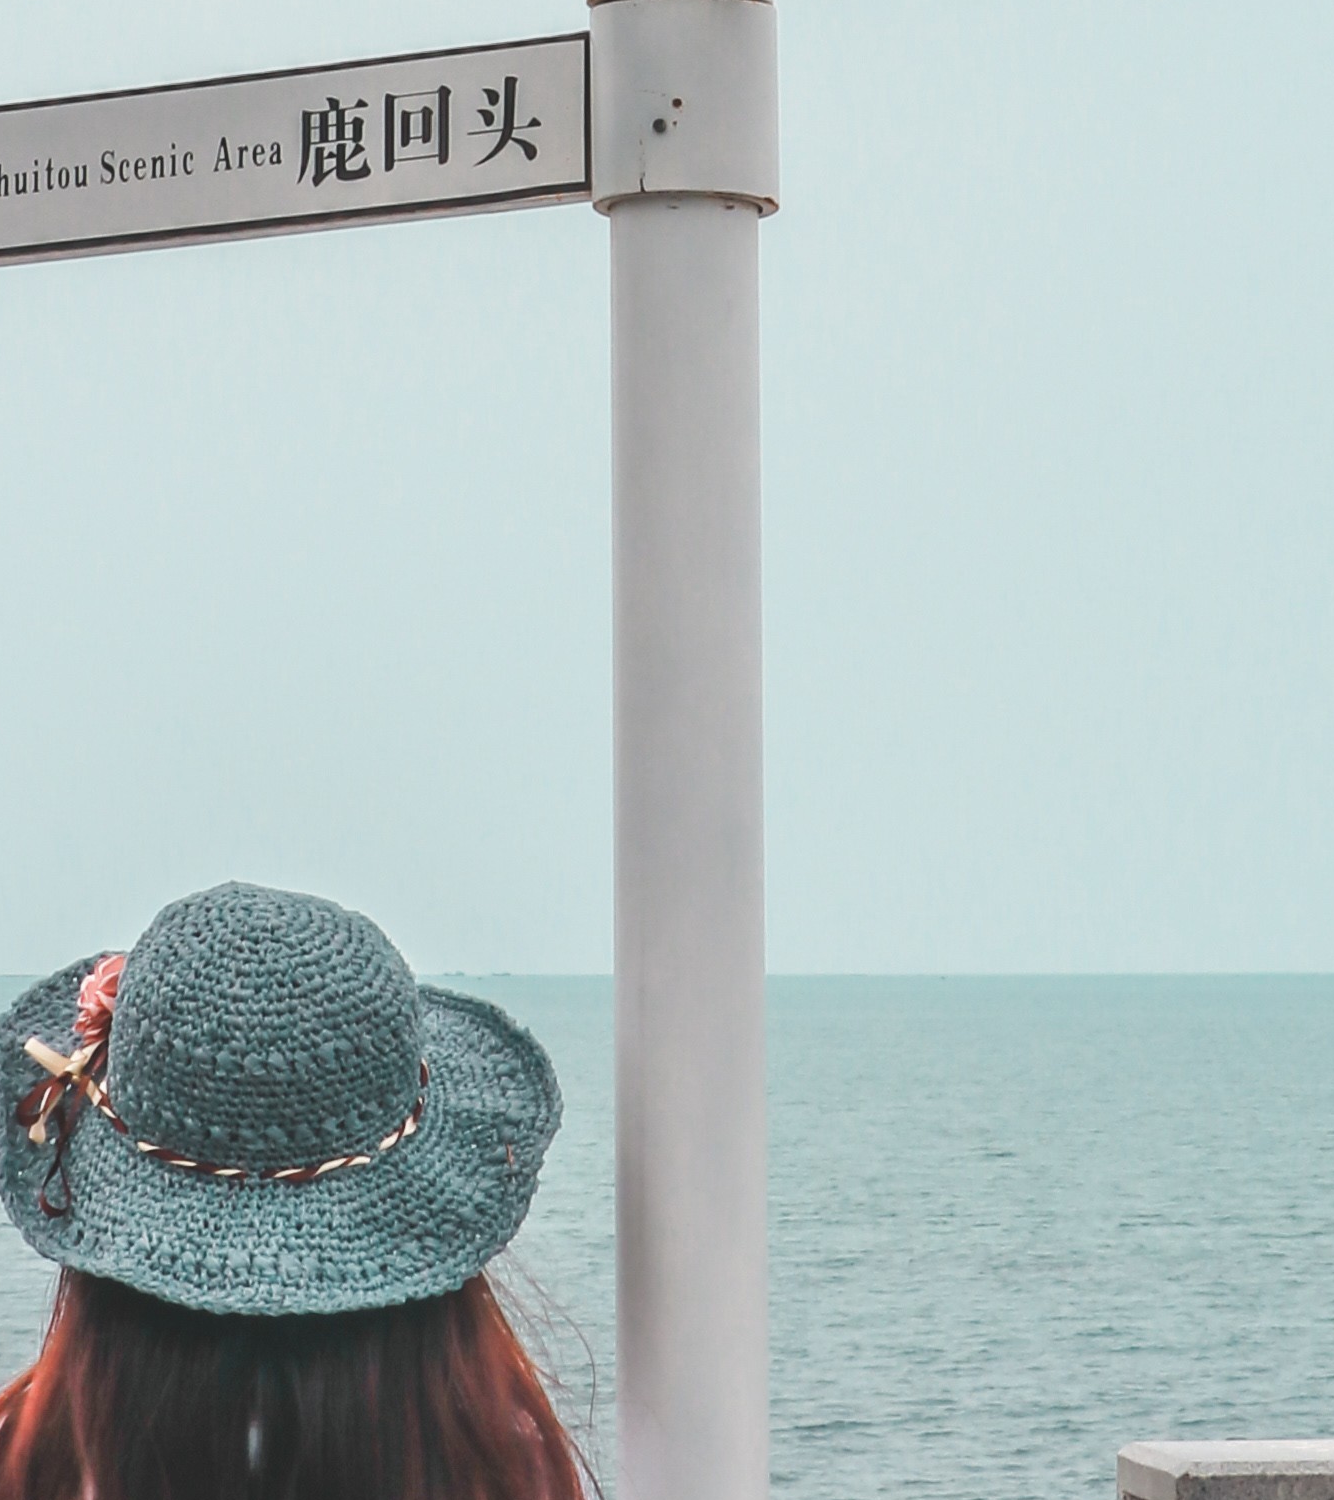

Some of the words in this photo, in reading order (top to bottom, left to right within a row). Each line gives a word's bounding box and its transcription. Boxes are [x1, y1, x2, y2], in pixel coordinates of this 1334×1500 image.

[101, 143, 193, 184] Scenic
[214, 137, 281, 172] Area
[297, 76, 541, 187] 鹿回头
